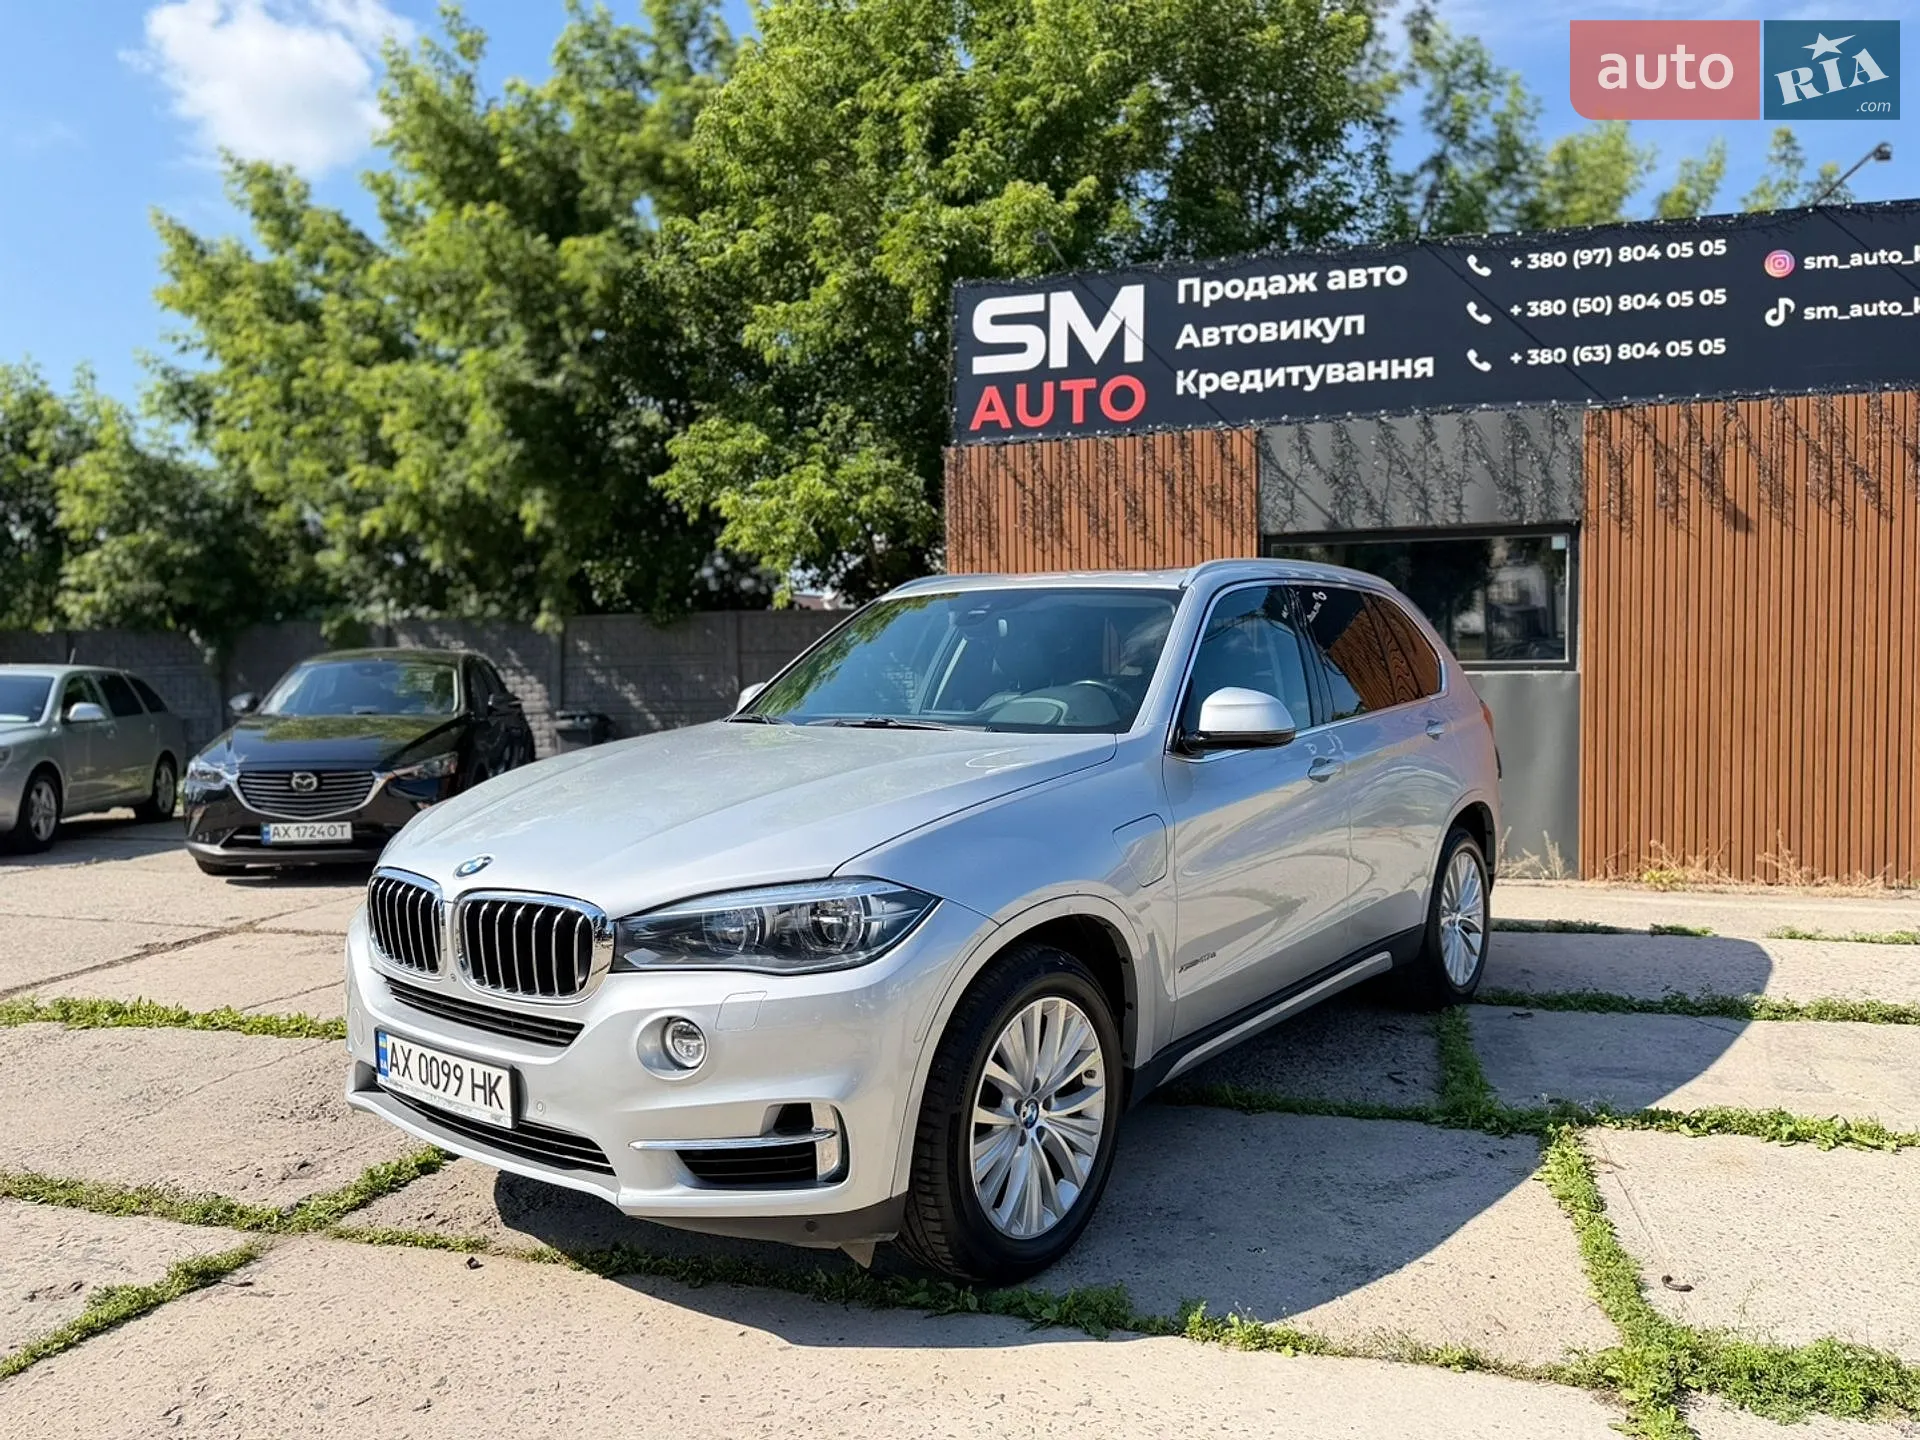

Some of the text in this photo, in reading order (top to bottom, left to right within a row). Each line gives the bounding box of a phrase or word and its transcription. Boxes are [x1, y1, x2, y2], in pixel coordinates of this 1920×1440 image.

[1527, 251, 1567, 269] 380
[1573, 247, 1612, 269] (97)
[1619, 244, 1661, 262] 804
[1667, 242, 1693, 258] 05
[1699, 239, 1726, 256] 05
[1178, 265, 1407, 307] Продаж авто
[1527, 299, 1566, 317] 380
[1573, 296, 1612, 317] (50)
[1618, 293, 1661, 310] 804
[1667, 291, 1693, 307] 05
[1699, 289, 1726, 305] 05
[973, 284, 1144, 374] SM
[1175, 315, 1364, 349] Автовикуп
[1527, 348, 1566, 365] 380
[1573, 344, 1611, 366] (63)
[1618, 342, 1661, 359] 804
[1666, 340, 1693, 357] 05
[1699, 338, 1726, 355] 05
[1177, 357, 1433, 399] Кредитування
[972, 376, 1146, 430] AUTO
[272, 824, 347, 838] AX 1724 OT
[390, 1042, 414, 1081] AX
[418, 1052, 464, 1097] 0099
[471, 1068, 504, 1110] HK
